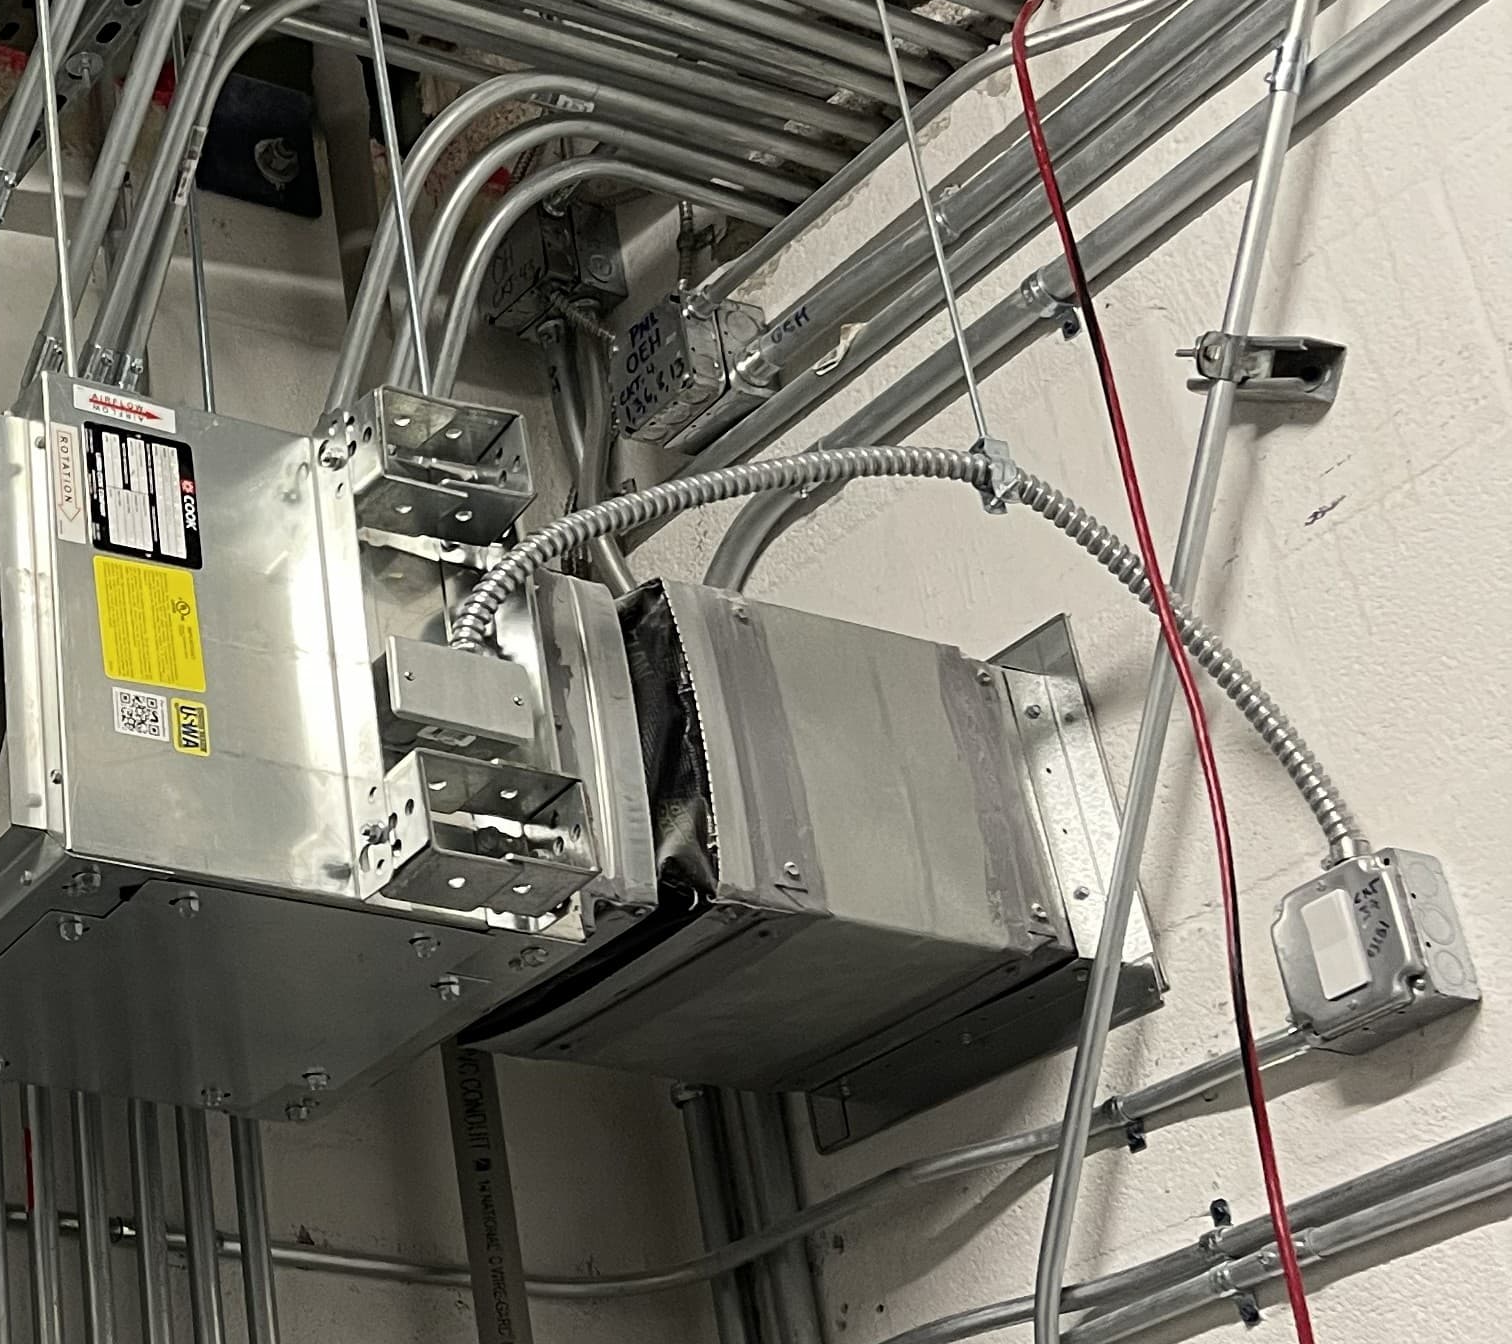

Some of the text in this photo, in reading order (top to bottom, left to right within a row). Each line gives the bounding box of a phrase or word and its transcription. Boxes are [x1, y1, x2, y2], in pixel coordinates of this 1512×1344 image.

[626, 329, 663, 374] OEH
[91, 392, 143, 412] AIRFLOW
[60, 435, 72, 502] ROTATION
[183, 494, 197, 531] COOK
[459, 1076, 491, 1151] CONDUIT
